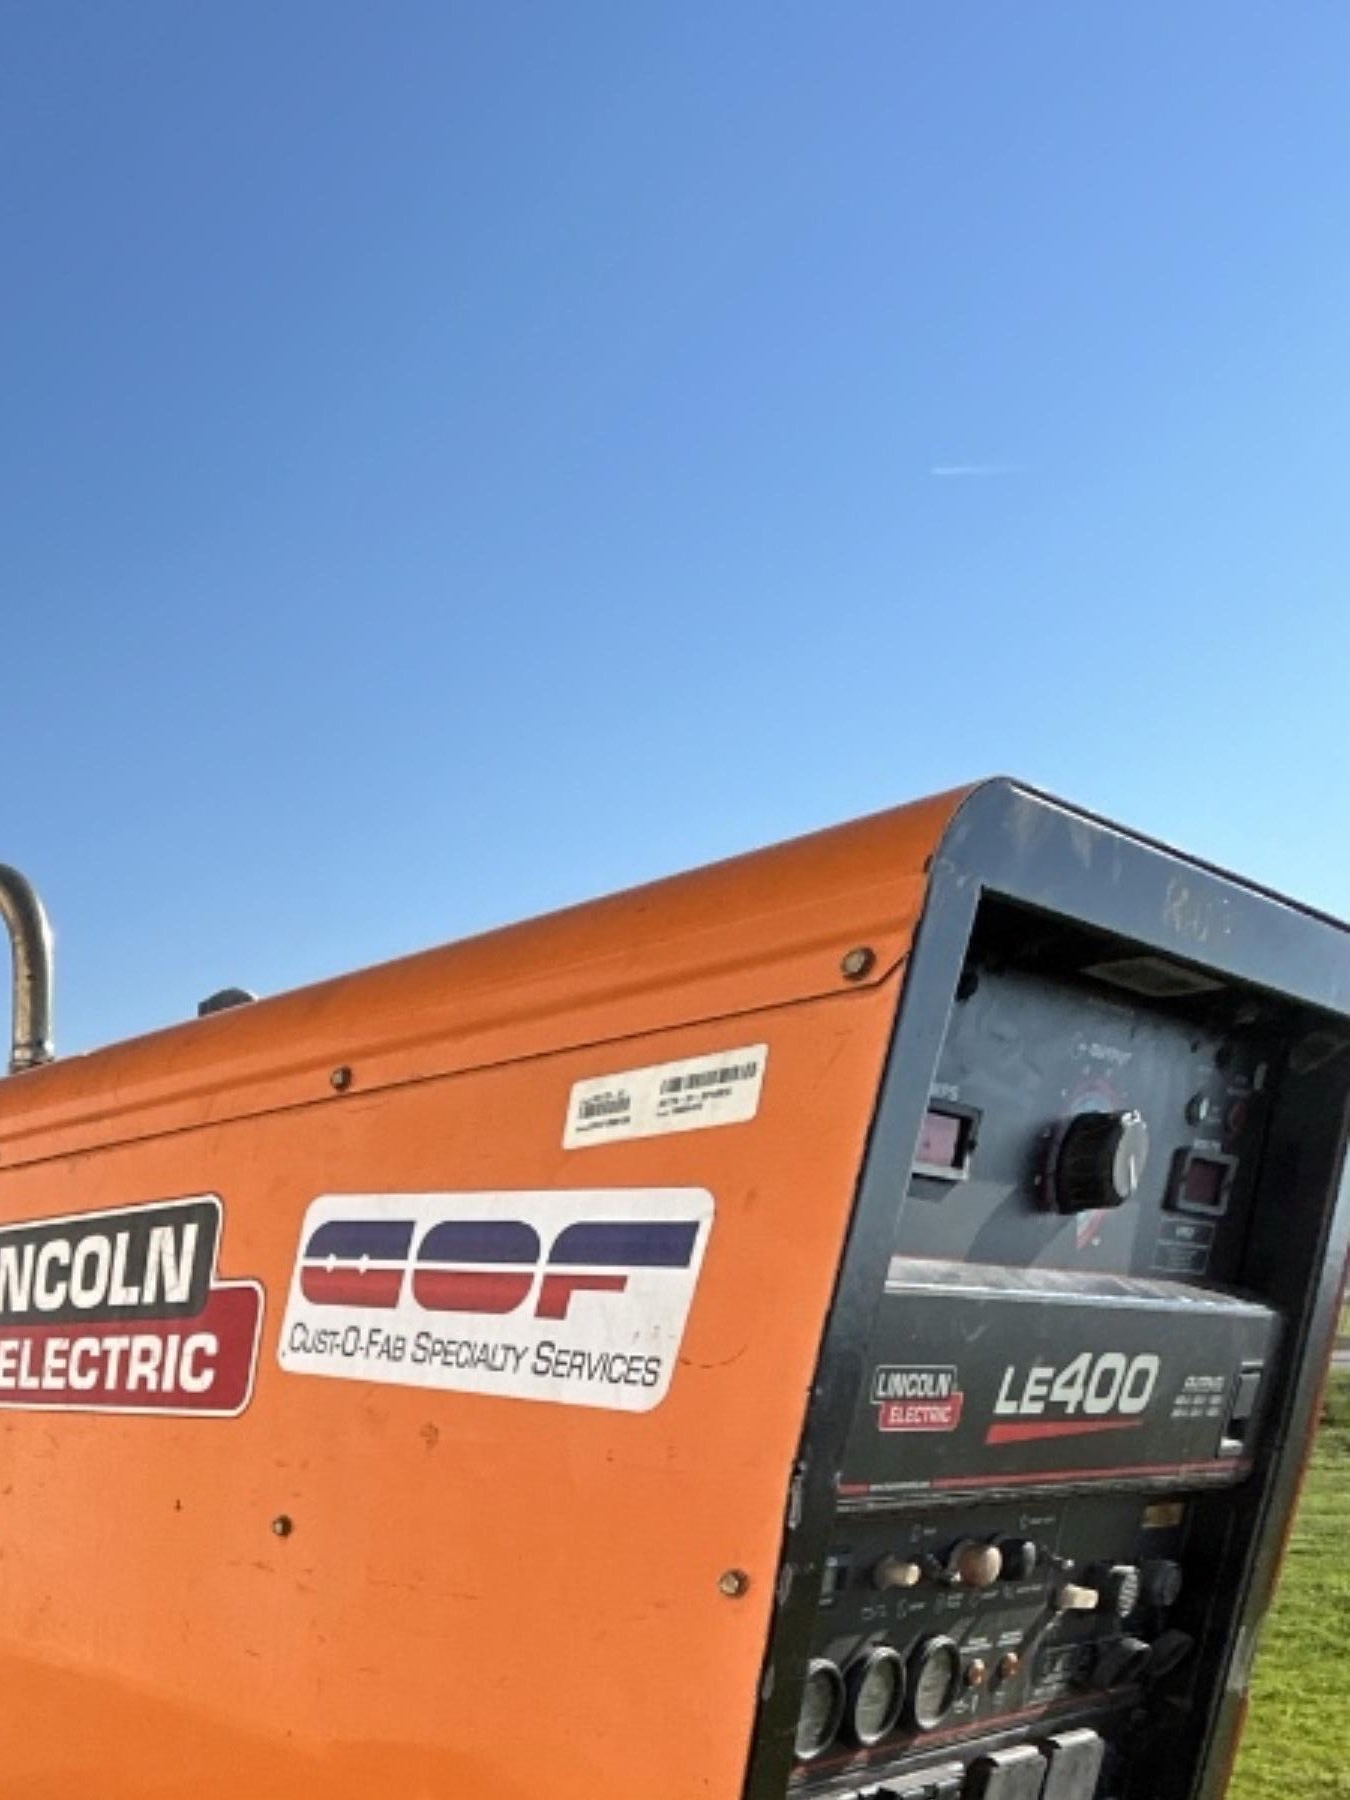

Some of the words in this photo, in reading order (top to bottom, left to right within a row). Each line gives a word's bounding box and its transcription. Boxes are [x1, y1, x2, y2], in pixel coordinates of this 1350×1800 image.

[876, 1371, 954, 1399] LINCOLN
[993, 1351, 1161, 1416] LE400
[888, 1405, 953, 1425] ELECTRIC
